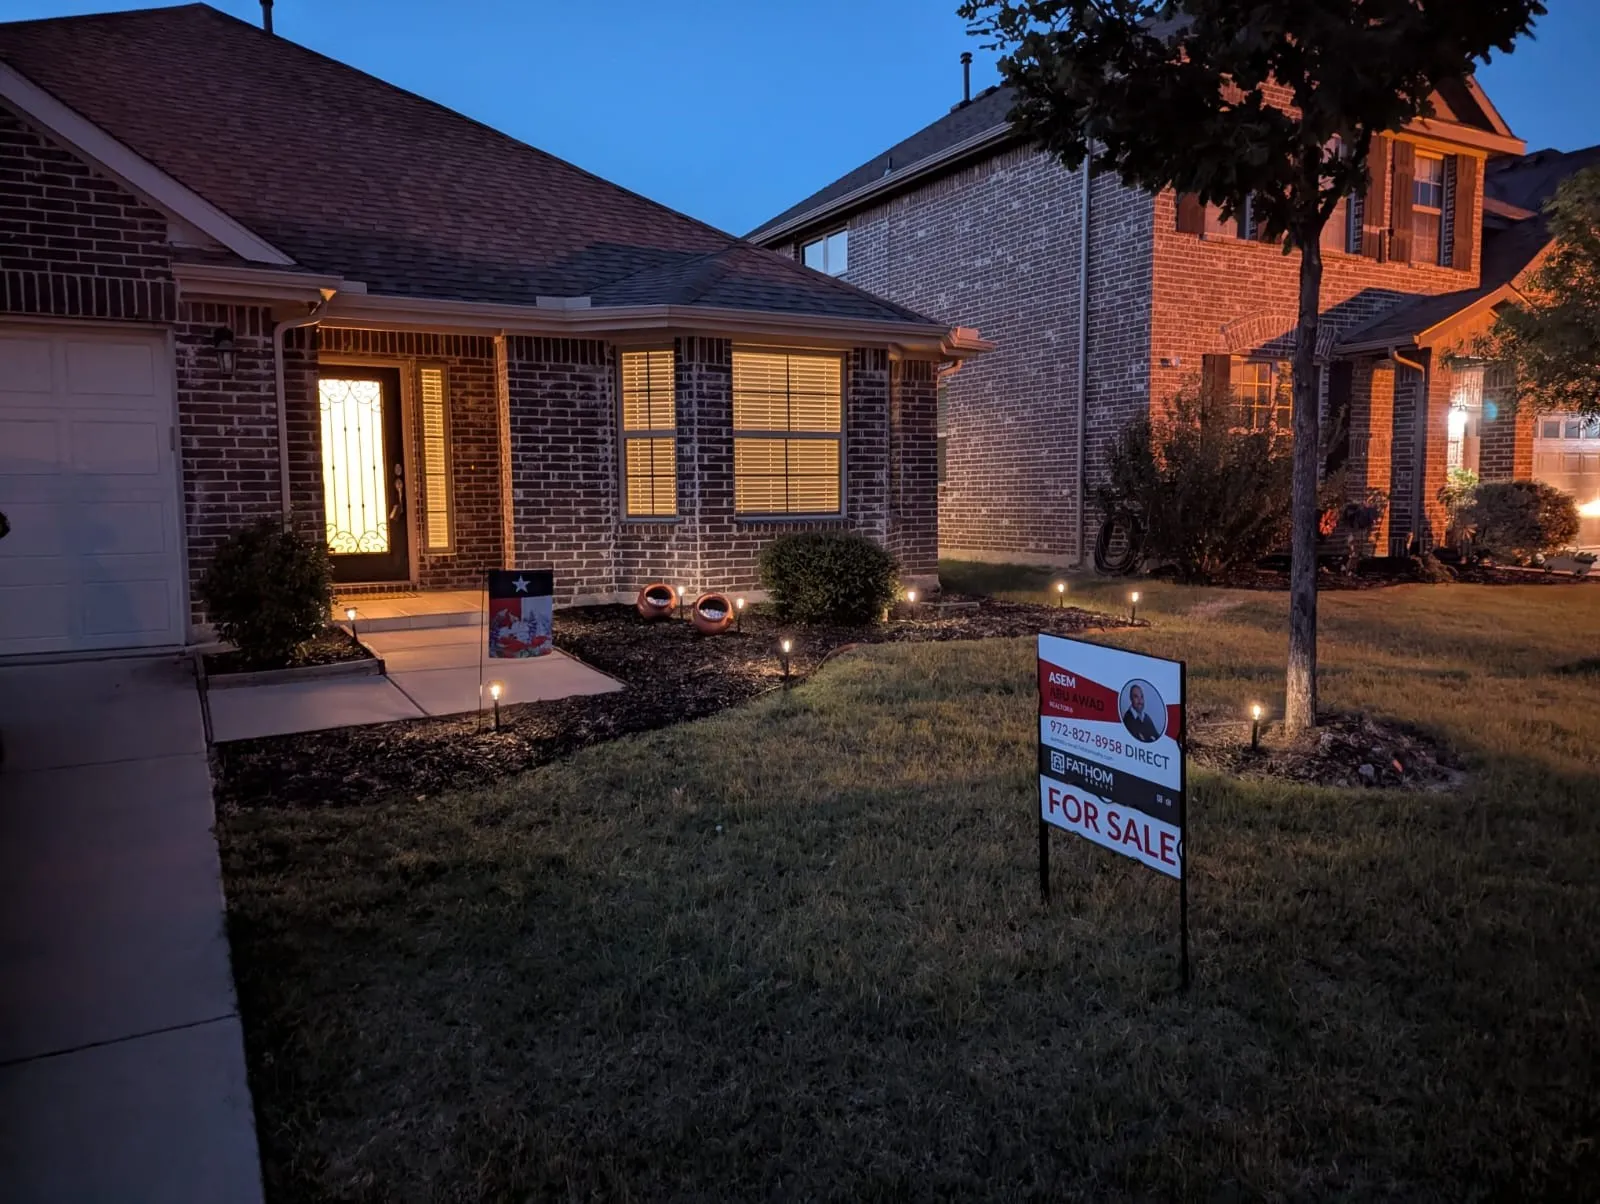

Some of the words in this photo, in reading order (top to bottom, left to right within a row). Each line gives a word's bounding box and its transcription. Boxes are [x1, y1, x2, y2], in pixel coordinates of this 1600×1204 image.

[1048, 671, 1076, 689] ASEM
[1049, 687, 1070, 702] ABU
[1071, 693, 1105, 712] AWAD
[1050, 720, 1123, 755] 972-827-8958
[1125, 744, 1170, 770] DIRECT
[1066, 757, 1114, 786] FATHOM
[1048, 786, 1101, 834] FOR
[1106, 811, 1177, 867] SALE
